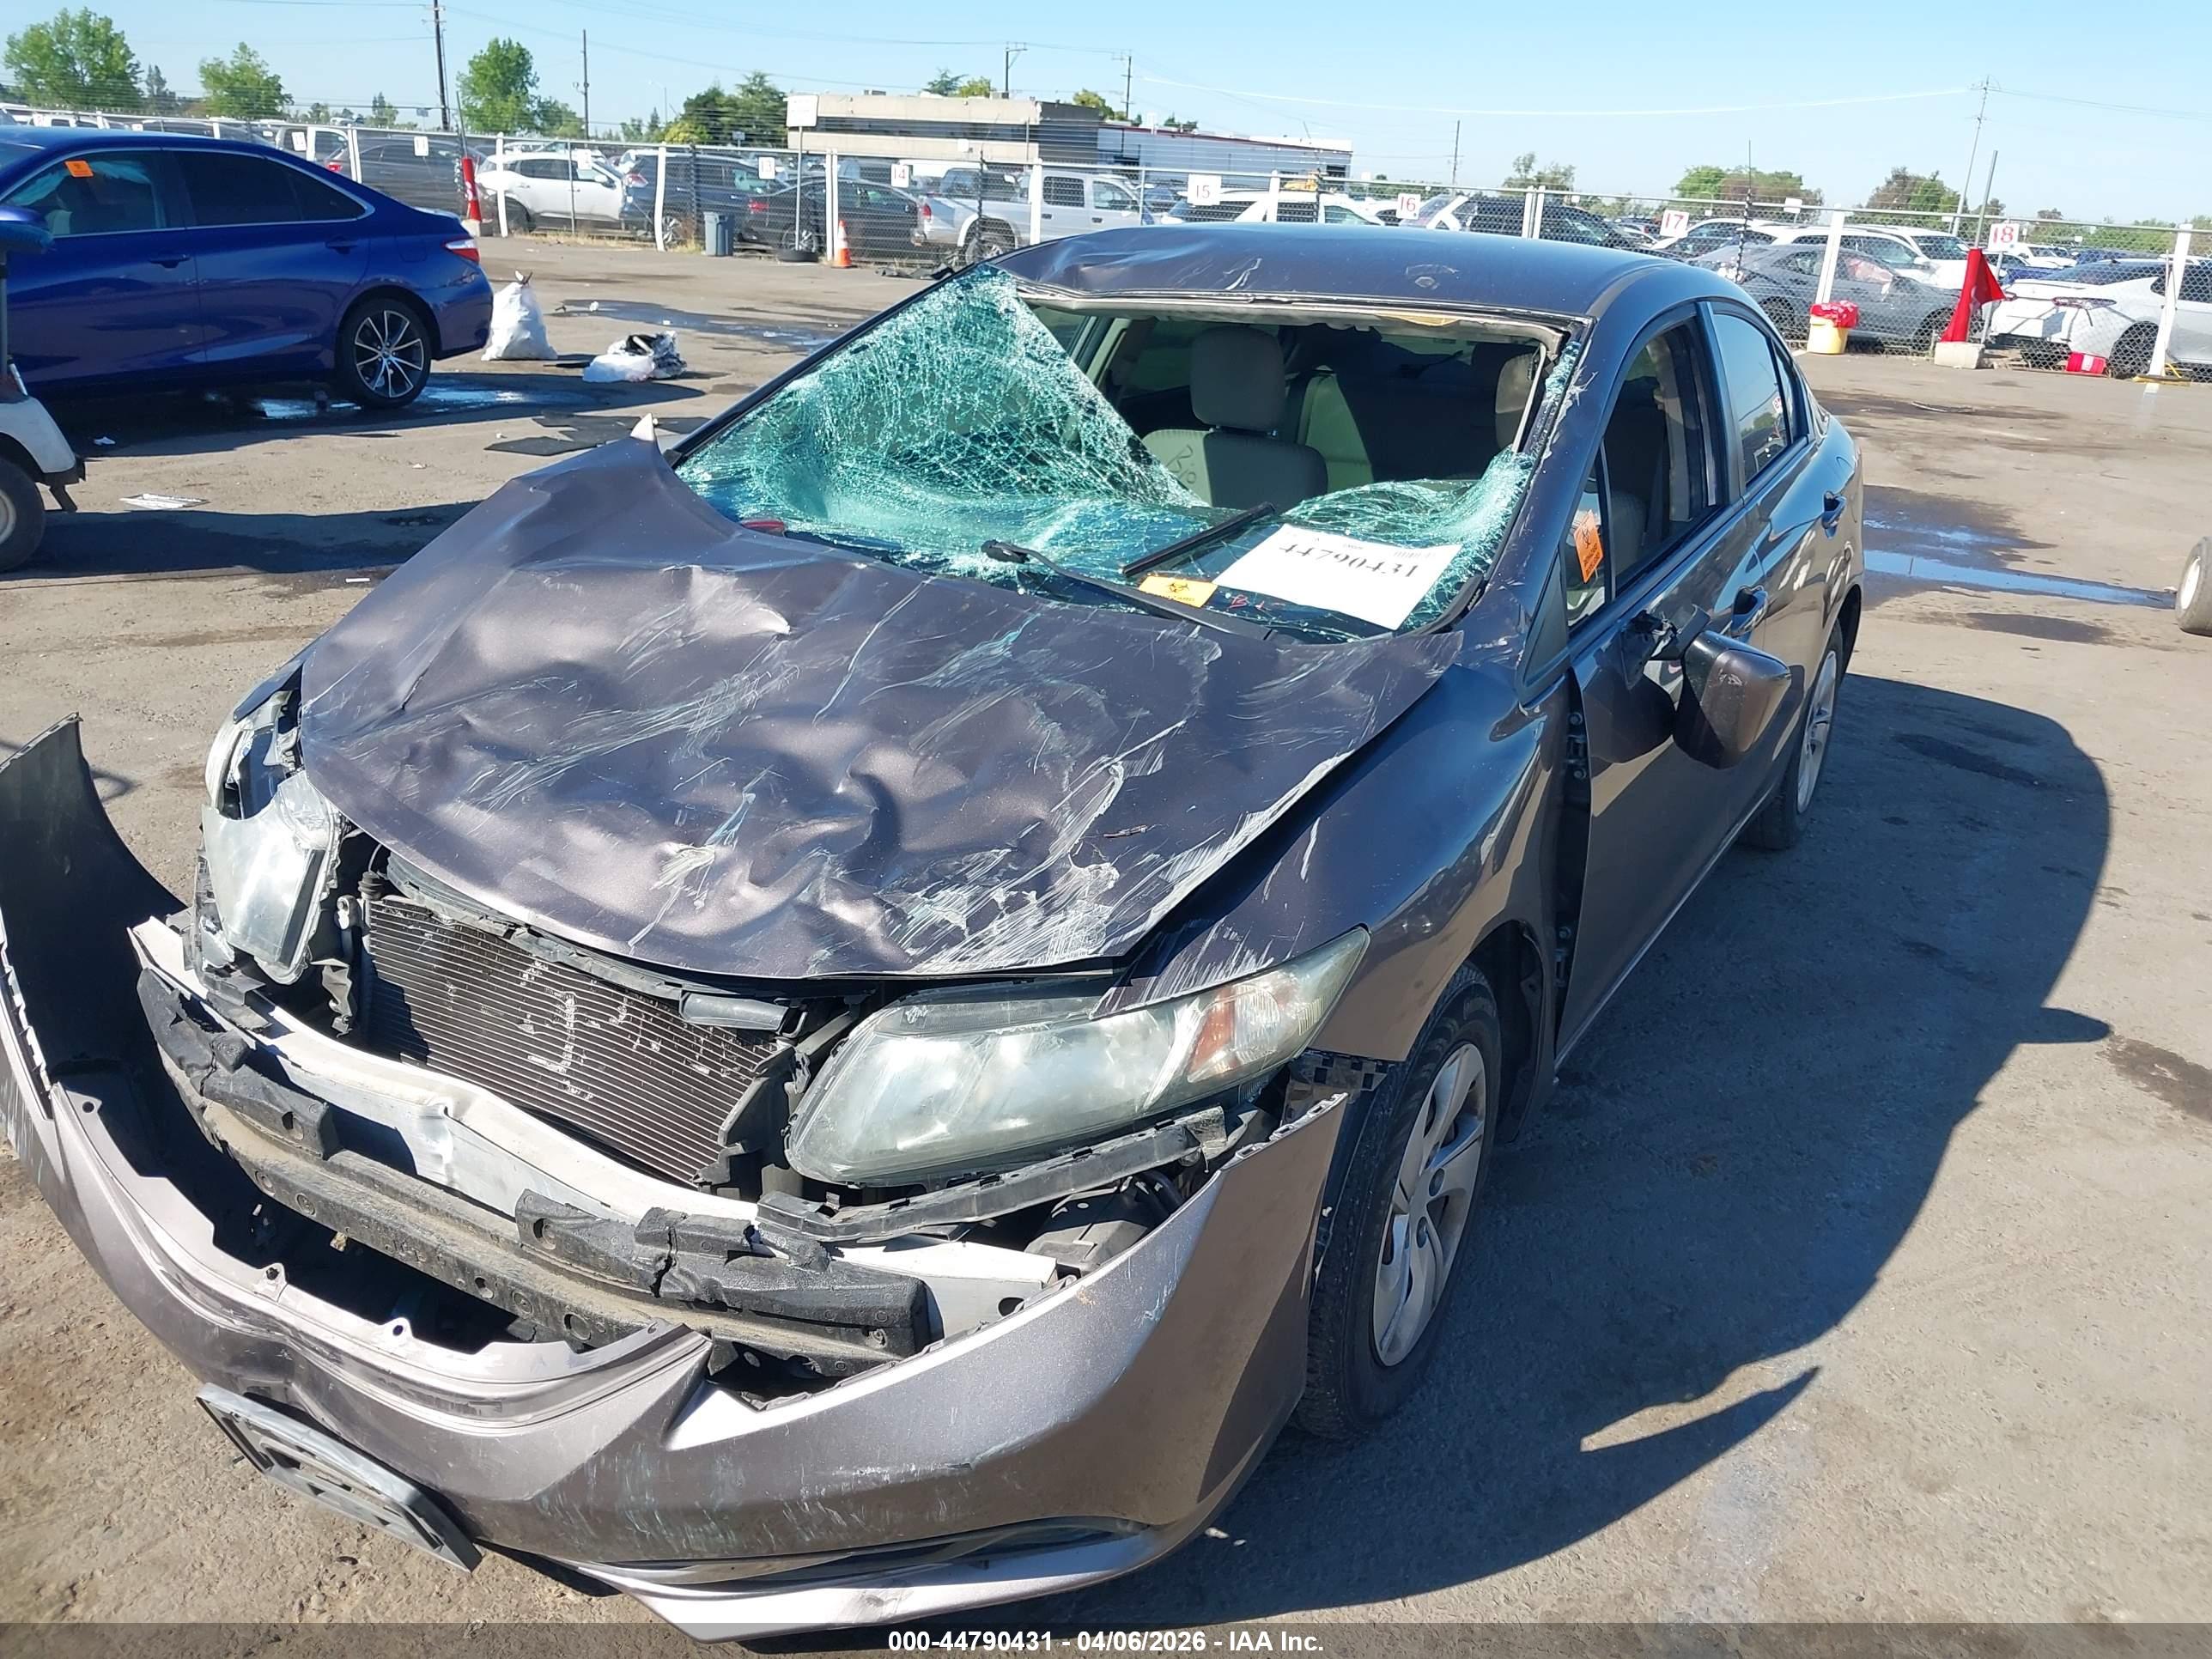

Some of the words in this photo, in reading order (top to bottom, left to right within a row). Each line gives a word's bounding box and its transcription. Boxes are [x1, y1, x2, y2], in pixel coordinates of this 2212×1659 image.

[894, 167, 907, 179] 14
[1196, 185, 1211, 199] 15
[1400, 196, 1416, 212] 16
[1665, 212, 1685, 229] 17
[1992, 225, 2014, 244] 18
[1278, 543, 1420, 578] 44790431
